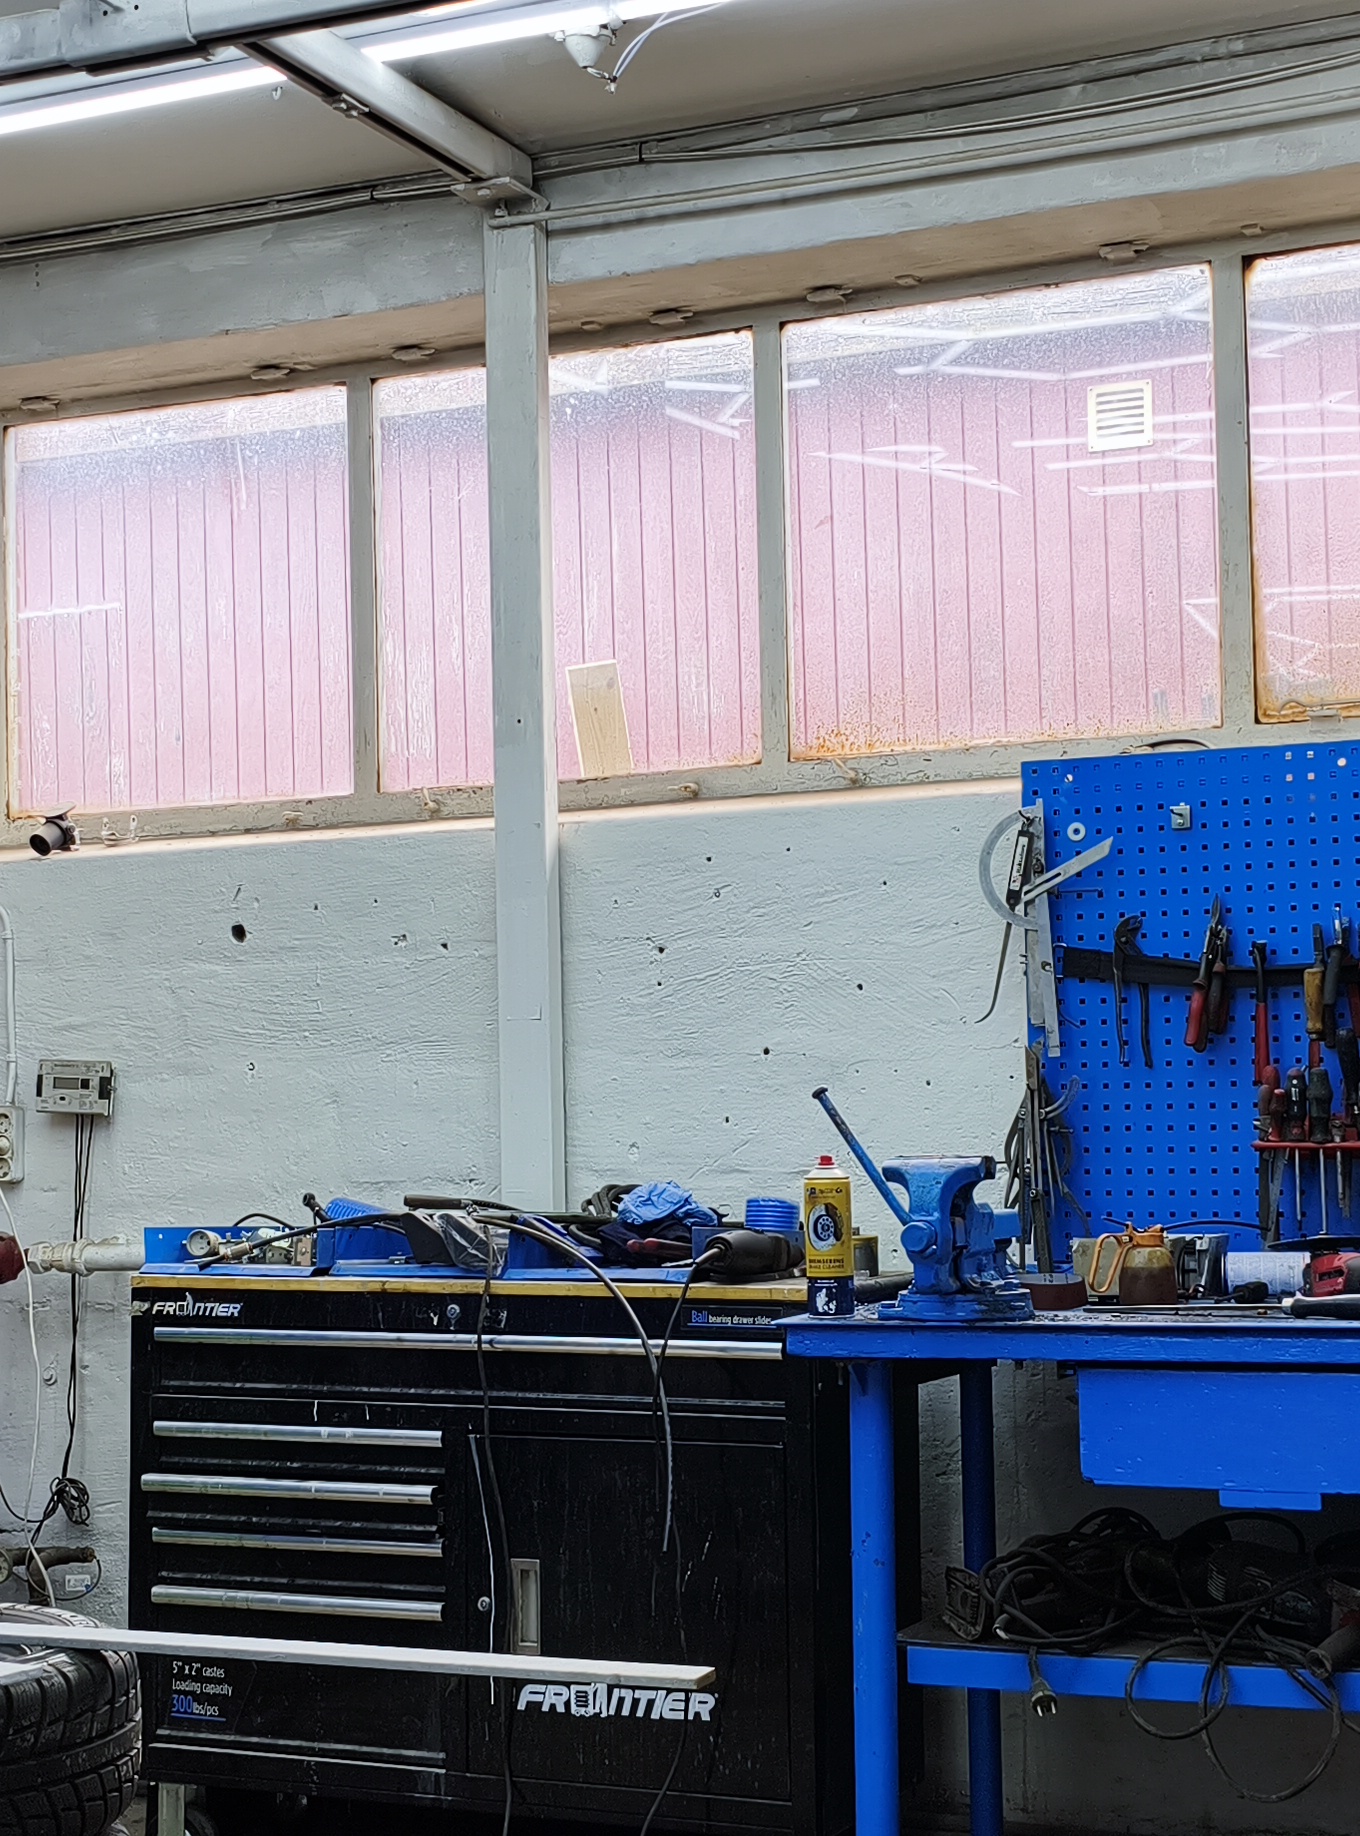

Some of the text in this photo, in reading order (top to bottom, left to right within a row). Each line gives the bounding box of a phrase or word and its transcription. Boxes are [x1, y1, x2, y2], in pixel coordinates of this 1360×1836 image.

[152, 1301, 242, 1317] FRONTIER
[691, 1310, 708, 1322] Ball
[708, 1314, 732, 1325] bearing
[732, 1315, 753, 1324] drawer
[184, 1664, 190, 1674] x
[172, 1678, 233, 1697] Loading capacity
[517, 1683, 716, 1721] FRONTIER
